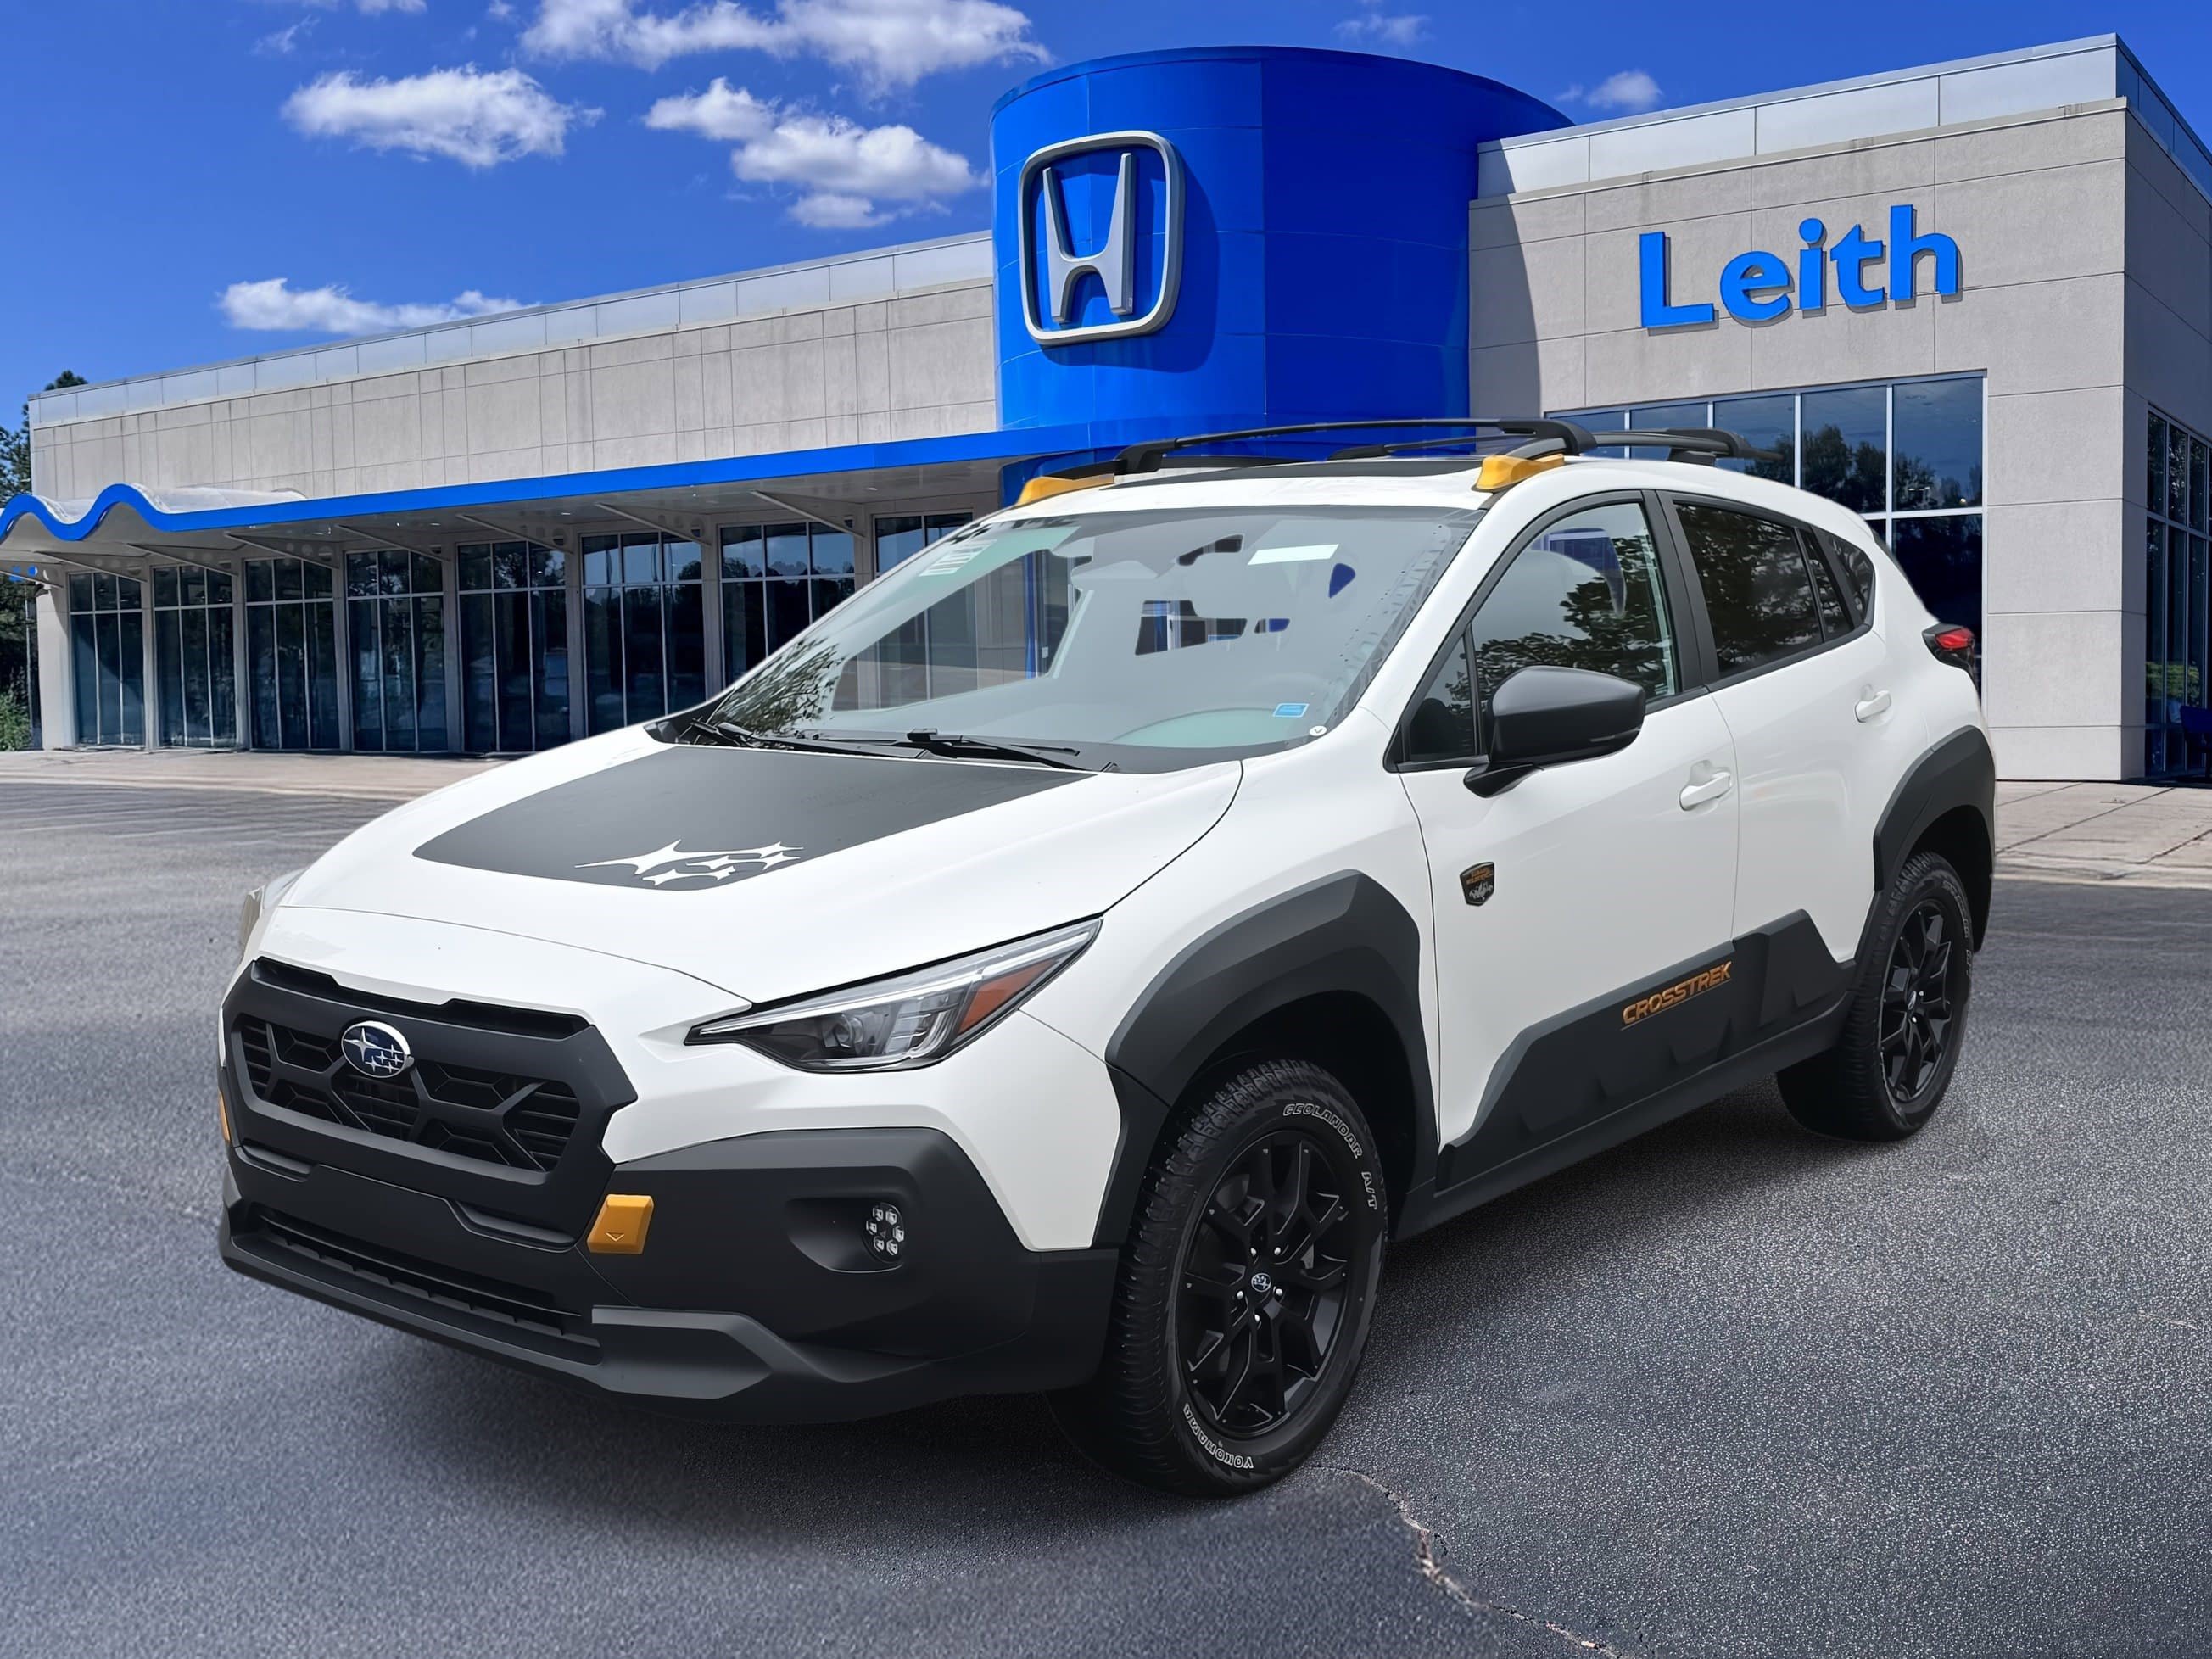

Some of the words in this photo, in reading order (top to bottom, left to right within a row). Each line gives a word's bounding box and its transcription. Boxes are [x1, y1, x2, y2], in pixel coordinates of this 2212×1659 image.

[1639, 204, 1961, 329] Leith
[1623, 961, 1732, 1025] CROSSTREK
[1282, 1103, 1363, 1159] GEOLANDAR
[1361, 1171, 1377, 1210] A/T
[1183, 1403, 1254, 1469] YOKOHAMA
